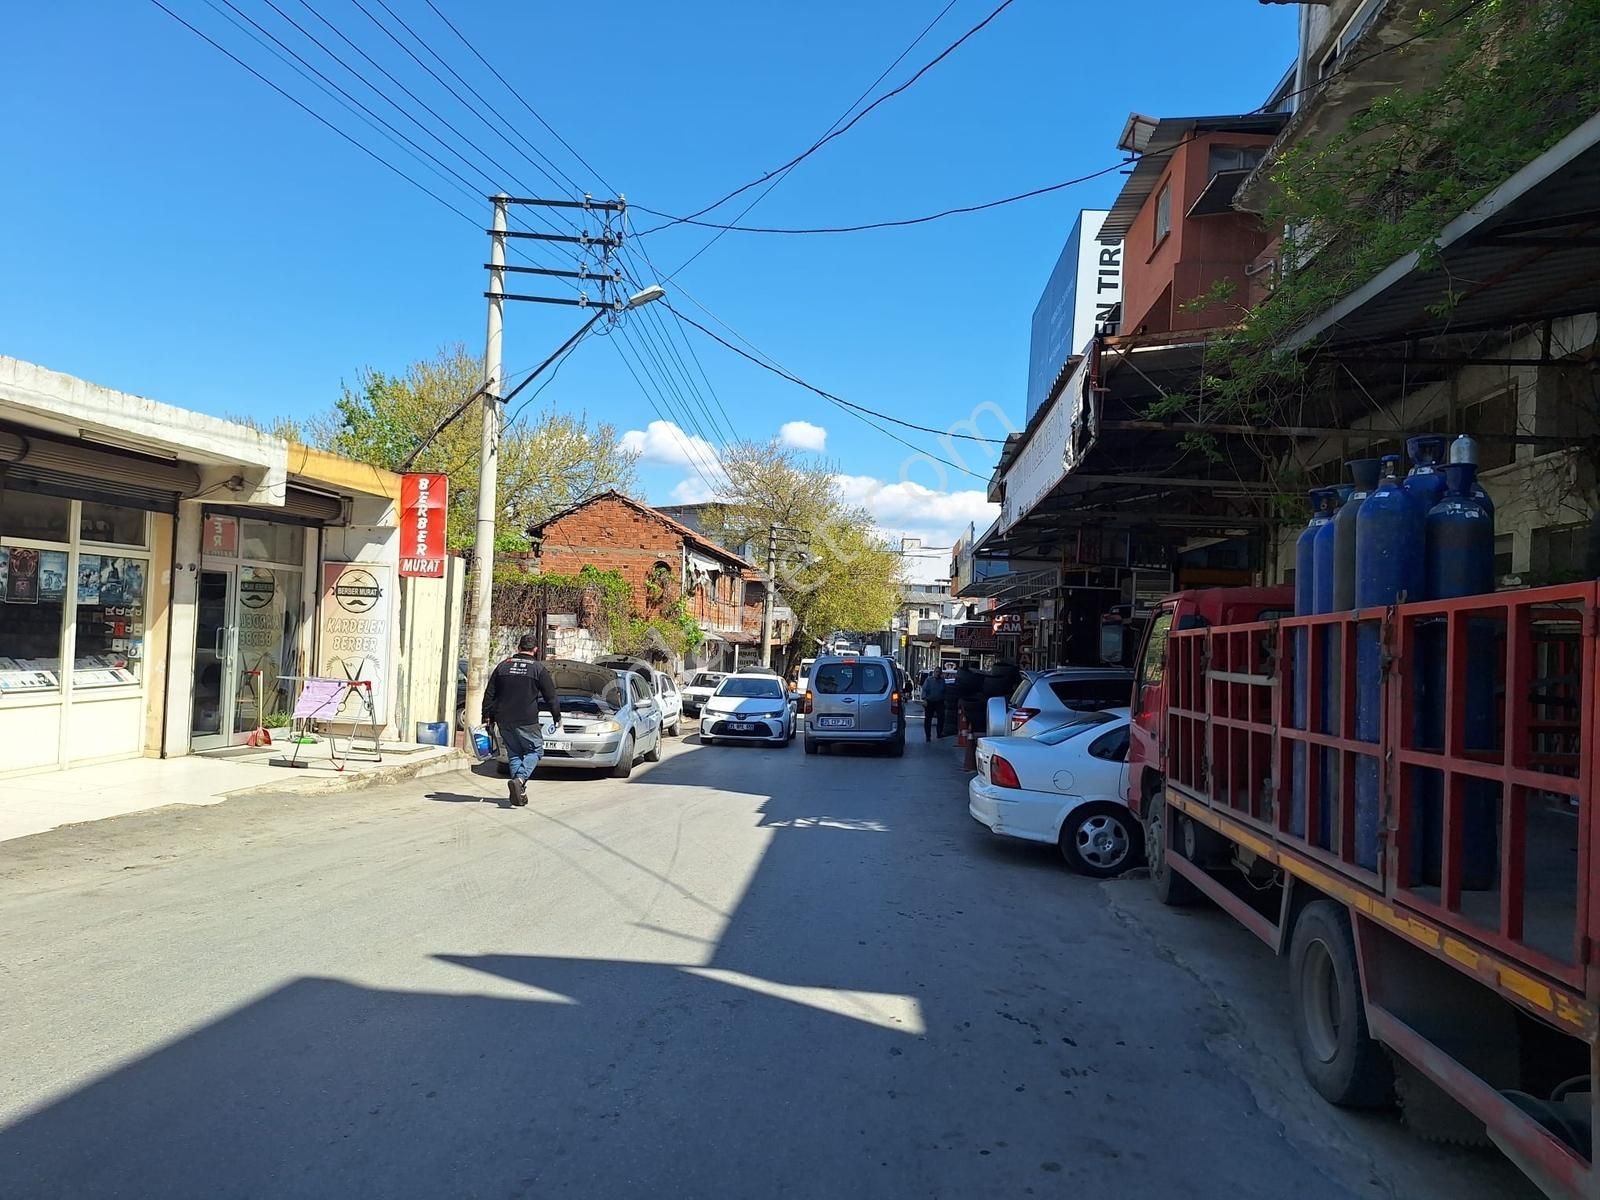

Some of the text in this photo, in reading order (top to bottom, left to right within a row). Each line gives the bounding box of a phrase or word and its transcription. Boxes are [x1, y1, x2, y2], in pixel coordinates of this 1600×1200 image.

[416, 478, 430, 556] BERBER
[402, 559, 441, 573] MURAT
[337, 587, 378, 596] BERBER MURAT
[994, 614, 1021, 622] OTO
[326, 618, 386, 635] KARDELEN
[993, 623, 1022, 632] CAM
[333, 635, 377, 652] BERBER
